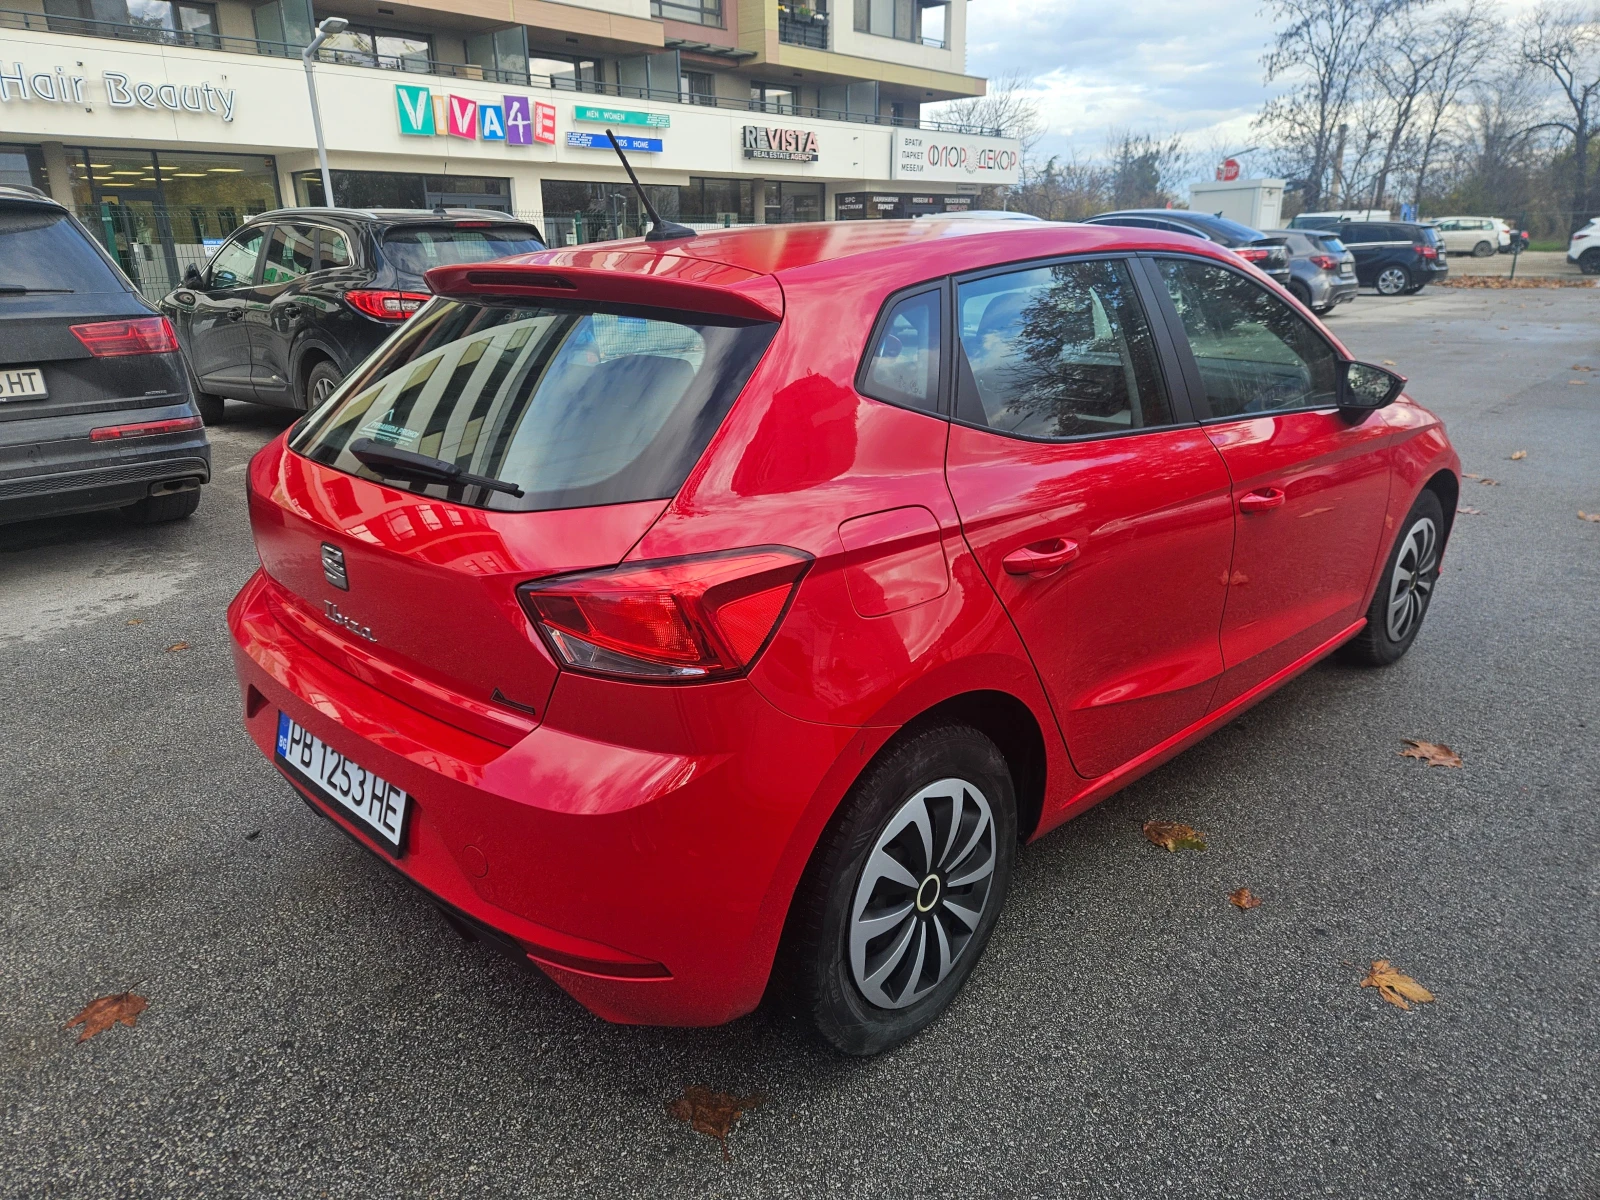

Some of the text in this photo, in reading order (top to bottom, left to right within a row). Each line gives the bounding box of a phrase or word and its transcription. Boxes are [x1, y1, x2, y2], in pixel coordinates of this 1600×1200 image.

[0, 61, 236, 122] Hair Beauty
[586, 110, 626, 121] MEN WOMEN
[633, 140, 649, 149] HOME
[743, 126, 819, 153] REVISTA
[905, 138, 923, 147] ВРАТИ
[753, 150, 813, 161] REAL ESTATE AGENCY
[902, 150, 924, 160] ПАРКЕТ
[978, 149, 1017, 171] ДЕКОР
[901, 163, 924, 172] МЕБЕЛИ
[324, 599, 378, 642] Ibiza
[278, 735, 287, 750] BG
[289, 721, 401, 835] PB 1253 HE
